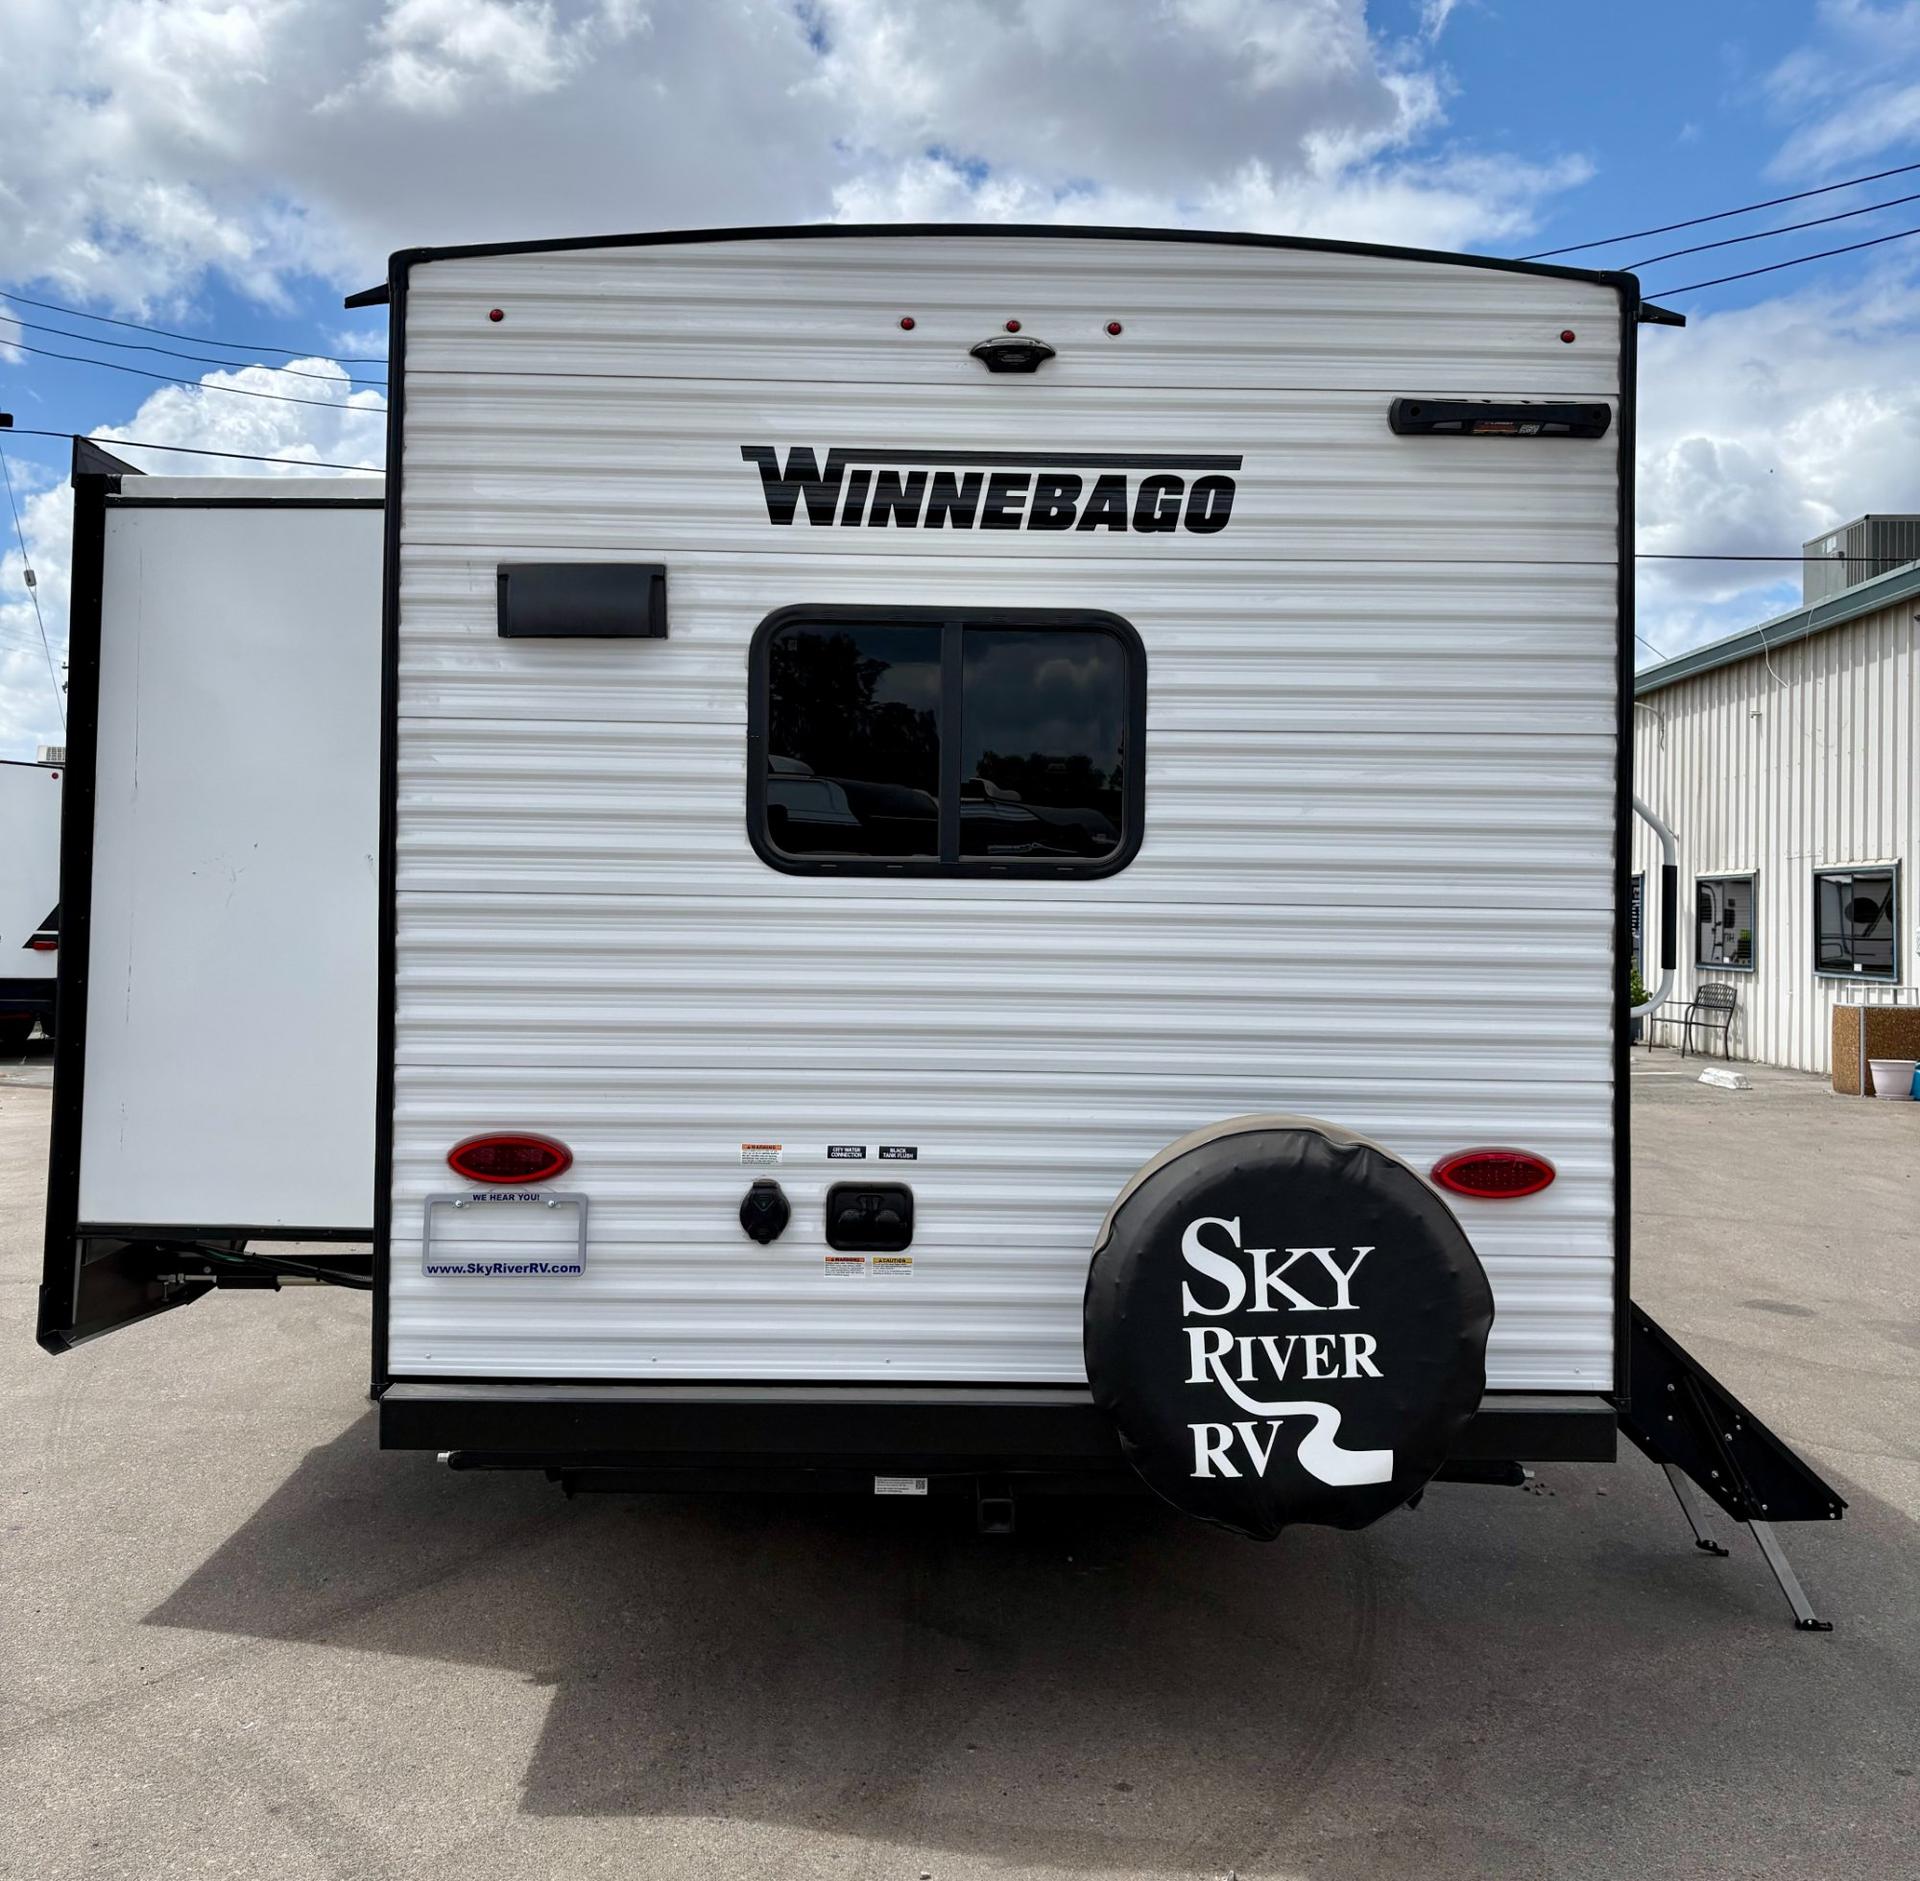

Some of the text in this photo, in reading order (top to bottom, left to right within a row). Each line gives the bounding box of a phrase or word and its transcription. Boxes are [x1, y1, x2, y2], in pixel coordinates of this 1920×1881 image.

[740, 445, 1243, 534] WINNEBAGO
[427, 1263, 581, 1276] www.SkyRiverRV.com
[1181, 1216, 1376, 1317] SKY
[1182, 1326, 1385, 1384] RIVER
[1187, 1420, 1284, 1478] RV
